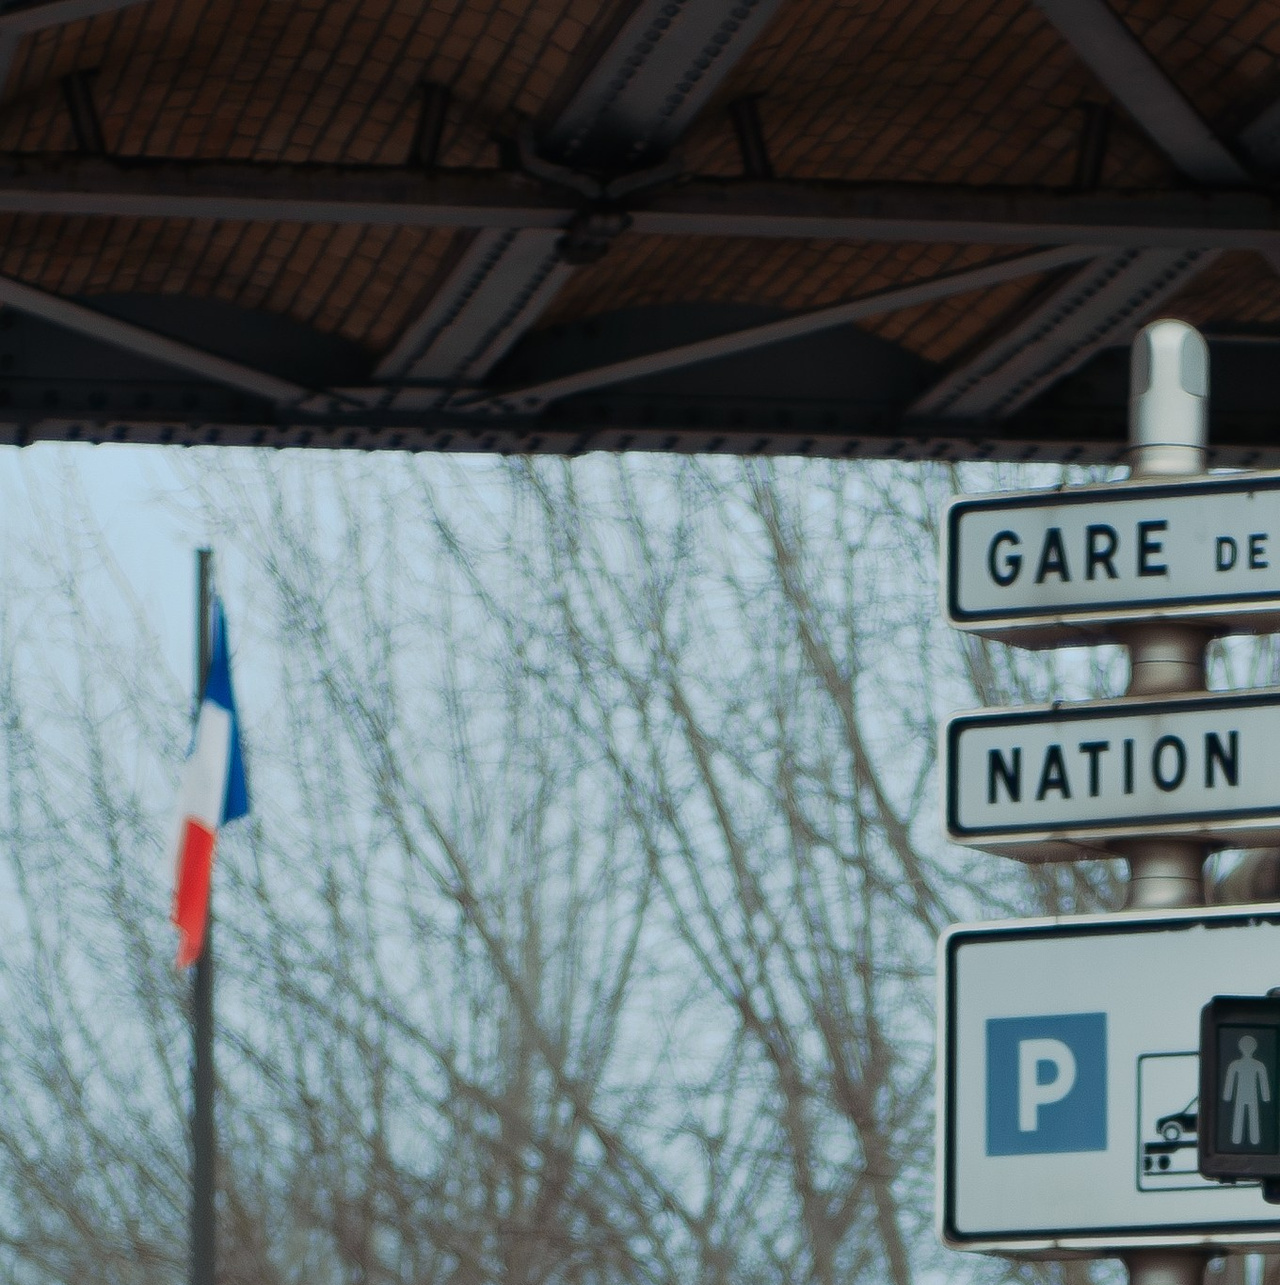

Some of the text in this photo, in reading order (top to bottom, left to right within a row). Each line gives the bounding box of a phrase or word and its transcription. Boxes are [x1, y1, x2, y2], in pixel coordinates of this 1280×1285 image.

[987, 519, 1170, 588] GARE
[1215, 533, 1270, 573] DE
[987, 730, 1240, 806] NATION
[1019, 1038, 1076, 1131] P
